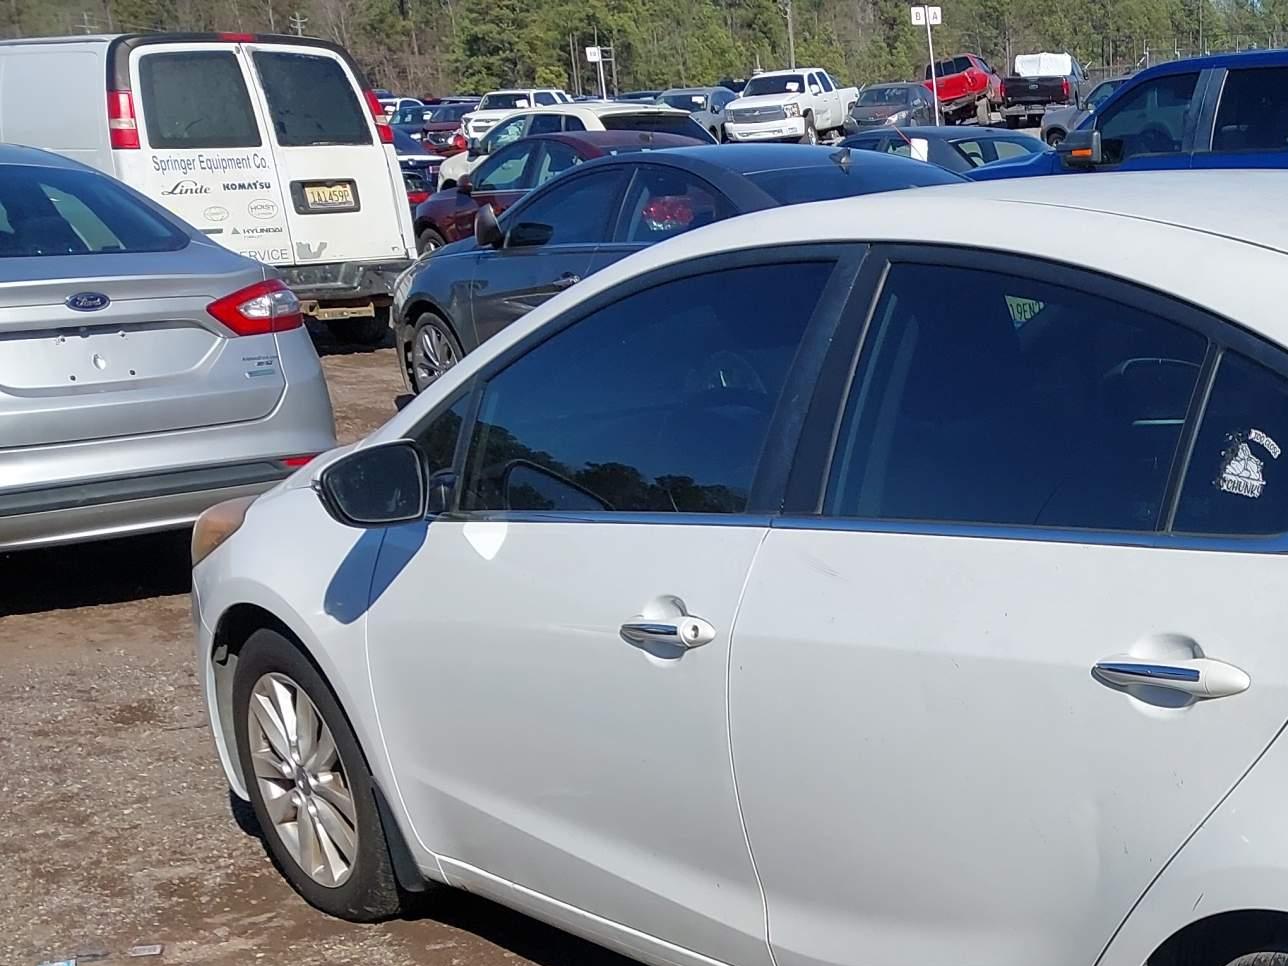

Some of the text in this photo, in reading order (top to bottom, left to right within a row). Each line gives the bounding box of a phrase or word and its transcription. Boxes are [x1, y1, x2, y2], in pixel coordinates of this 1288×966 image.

[152, 153, 270, 175] Springer Equipment Co.
[161, 180, 211, 195] Linde
[222, 180, 271, 191] KOMATSU
[250, 204, 275, 212] HOIST
